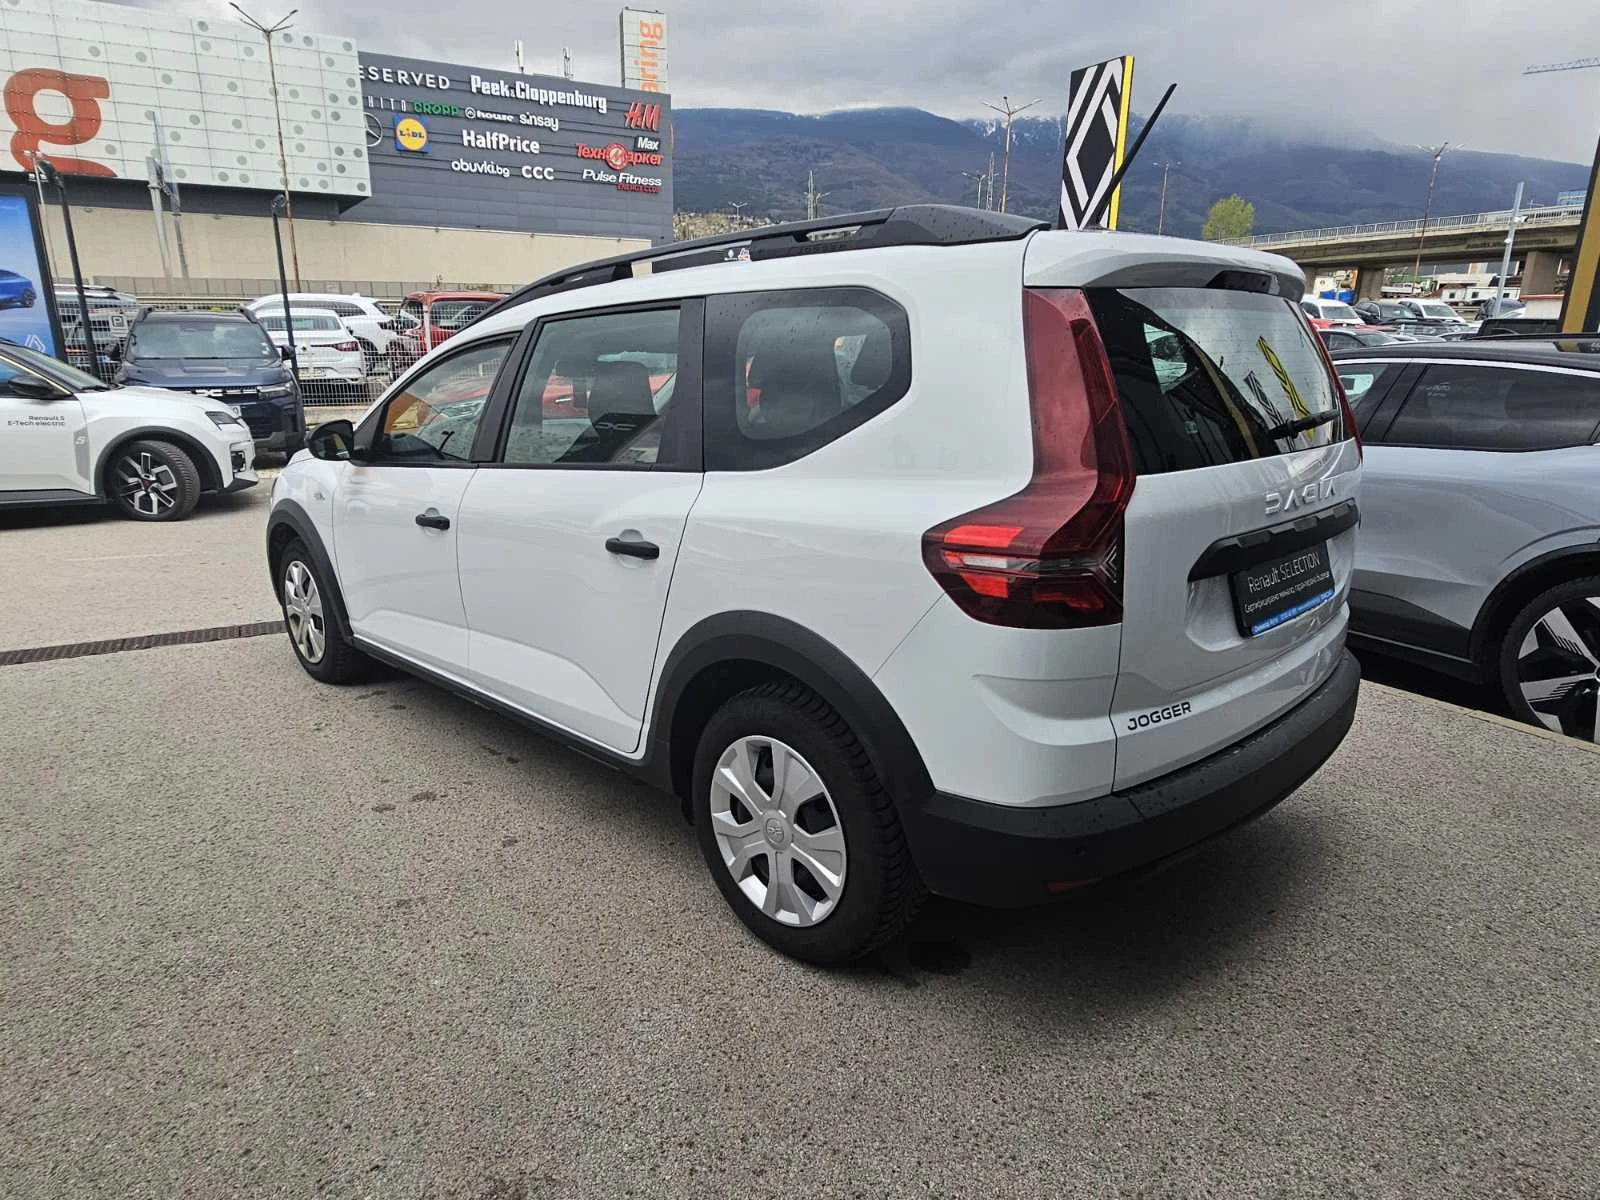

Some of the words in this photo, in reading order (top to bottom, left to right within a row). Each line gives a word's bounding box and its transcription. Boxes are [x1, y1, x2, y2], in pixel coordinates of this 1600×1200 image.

[3, 67, 119, 178] g
[624, 101, 661, 132] H&M
[461, 129, 540, 154] HalfPrice
[637, 136, 660, 151] Max
[451, 158, 510, 178] obuvki.bg
[521, 165, 555, 180] CCC
[582, 169, 617, 183] Pulse
[618, 172, 662, 187] Fitness
[1264, 478, 1336, 515] DACIA
[1247, 567, 1280, 593] Renault
[1279, 551, 1321, 581] SELECTION
[1127, 701, 1192, 731] JOGGER
